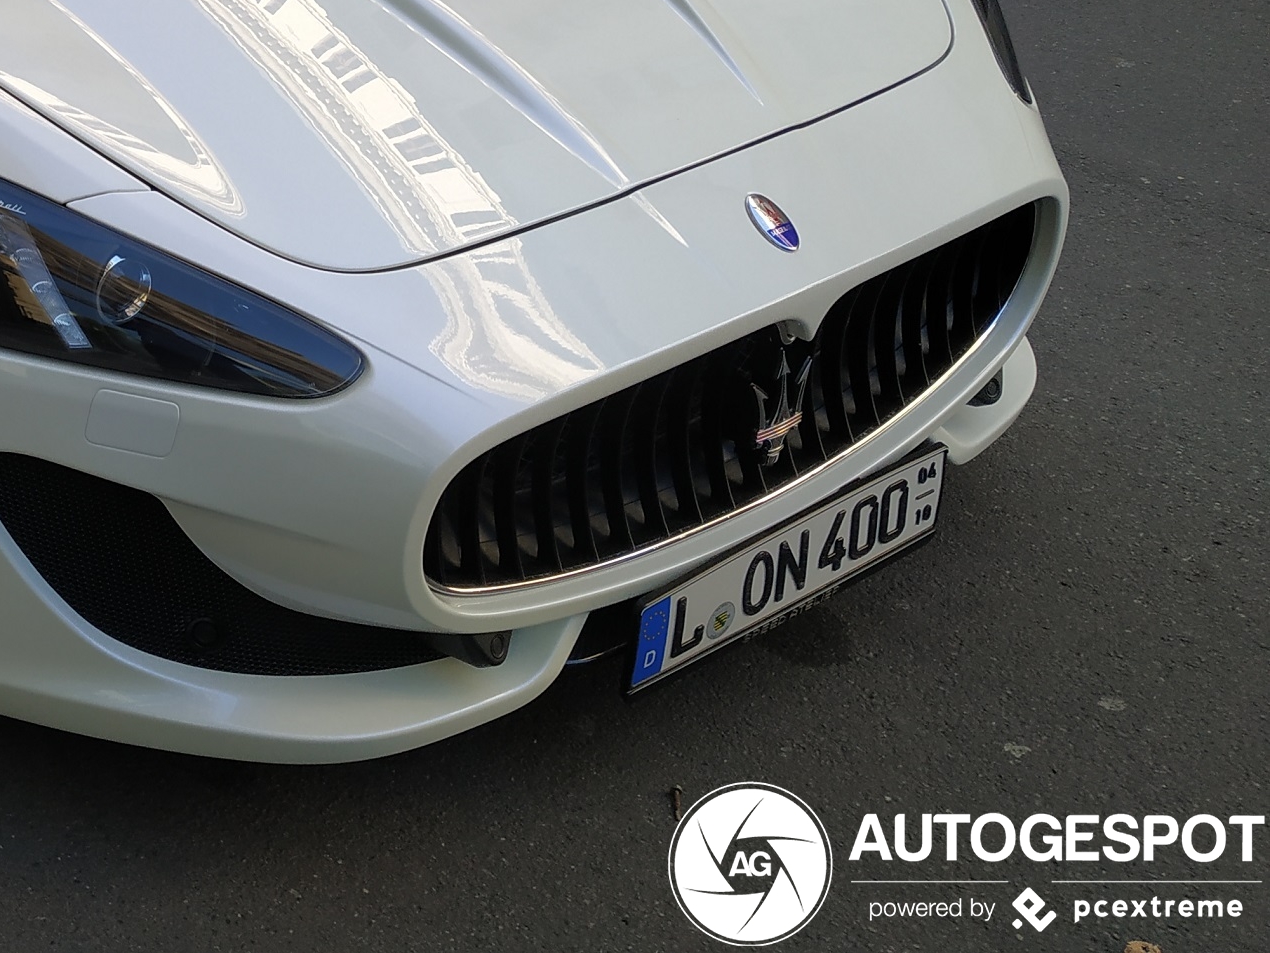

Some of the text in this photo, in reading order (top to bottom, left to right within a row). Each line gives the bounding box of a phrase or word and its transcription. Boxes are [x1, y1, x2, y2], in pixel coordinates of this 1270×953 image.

[918, 462, 937, 484] 04
[670, 479, 909, 658] L ON 400
[643, 650, 656, 669] D
